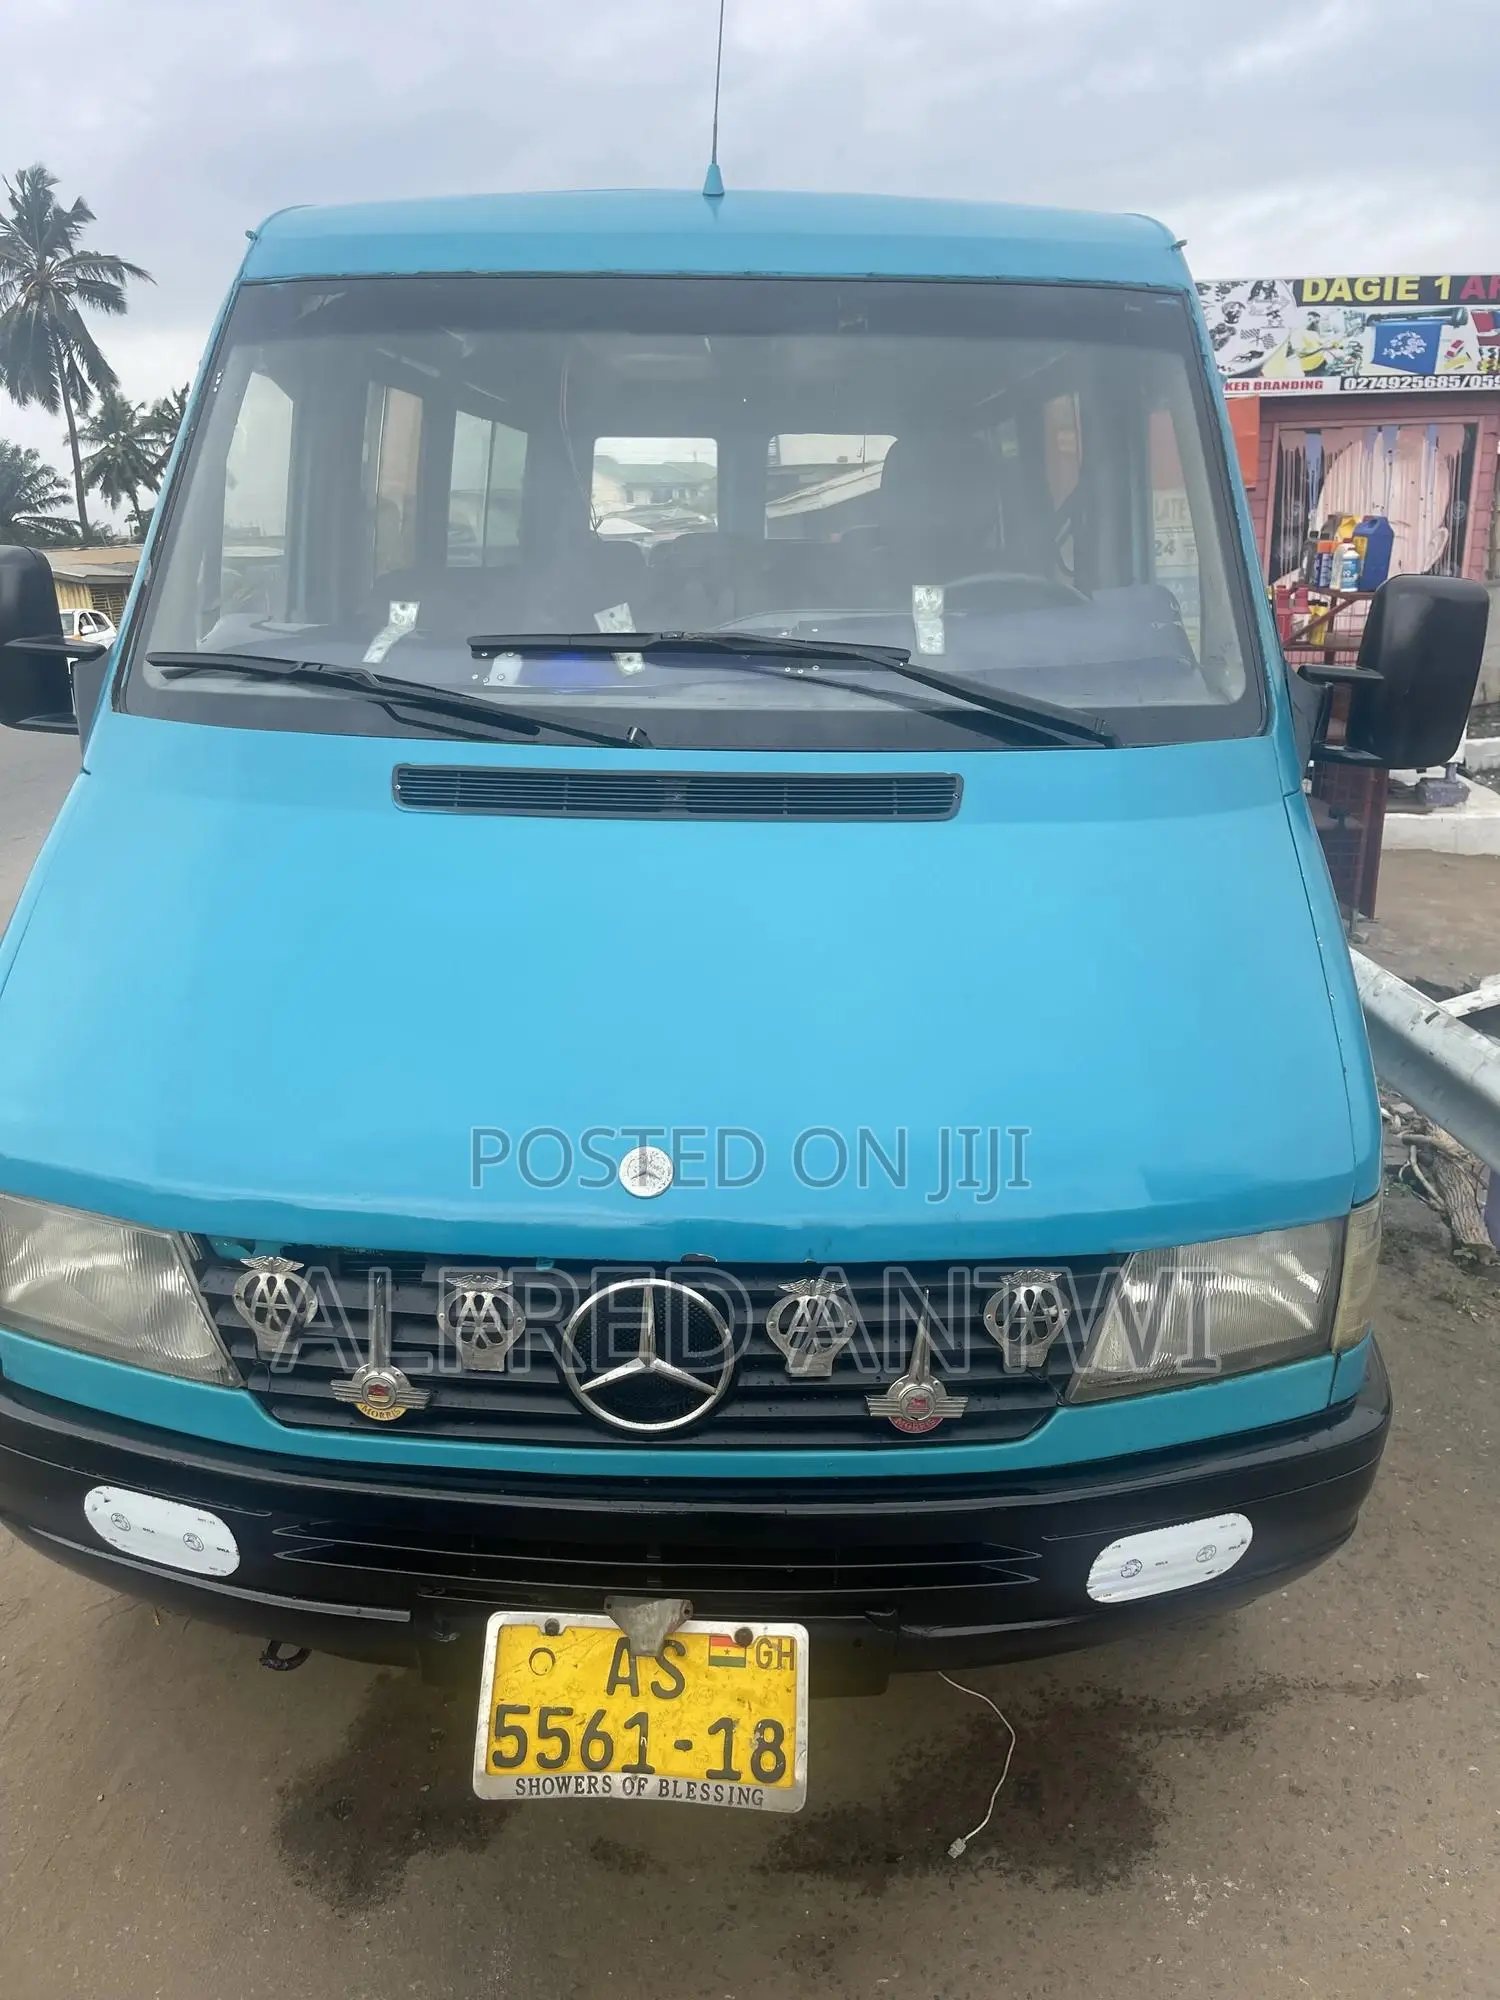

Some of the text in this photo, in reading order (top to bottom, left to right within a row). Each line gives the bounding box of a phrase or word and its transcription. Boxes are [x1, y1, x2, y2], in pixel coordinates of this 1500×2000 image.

[1302, 275, 1419, 302] DAGIE
[1434, 275, 1452, 300] 1
[1253, 380, 1324, 391] BRANDING
[361, 1404, 401, 1419] MORRIS
[606, 1636, 687, 1700] AS
[755, 1637, 796, 1672] GH
[515, 1774, 765, 1808] SHOWERS OF BLESSING
